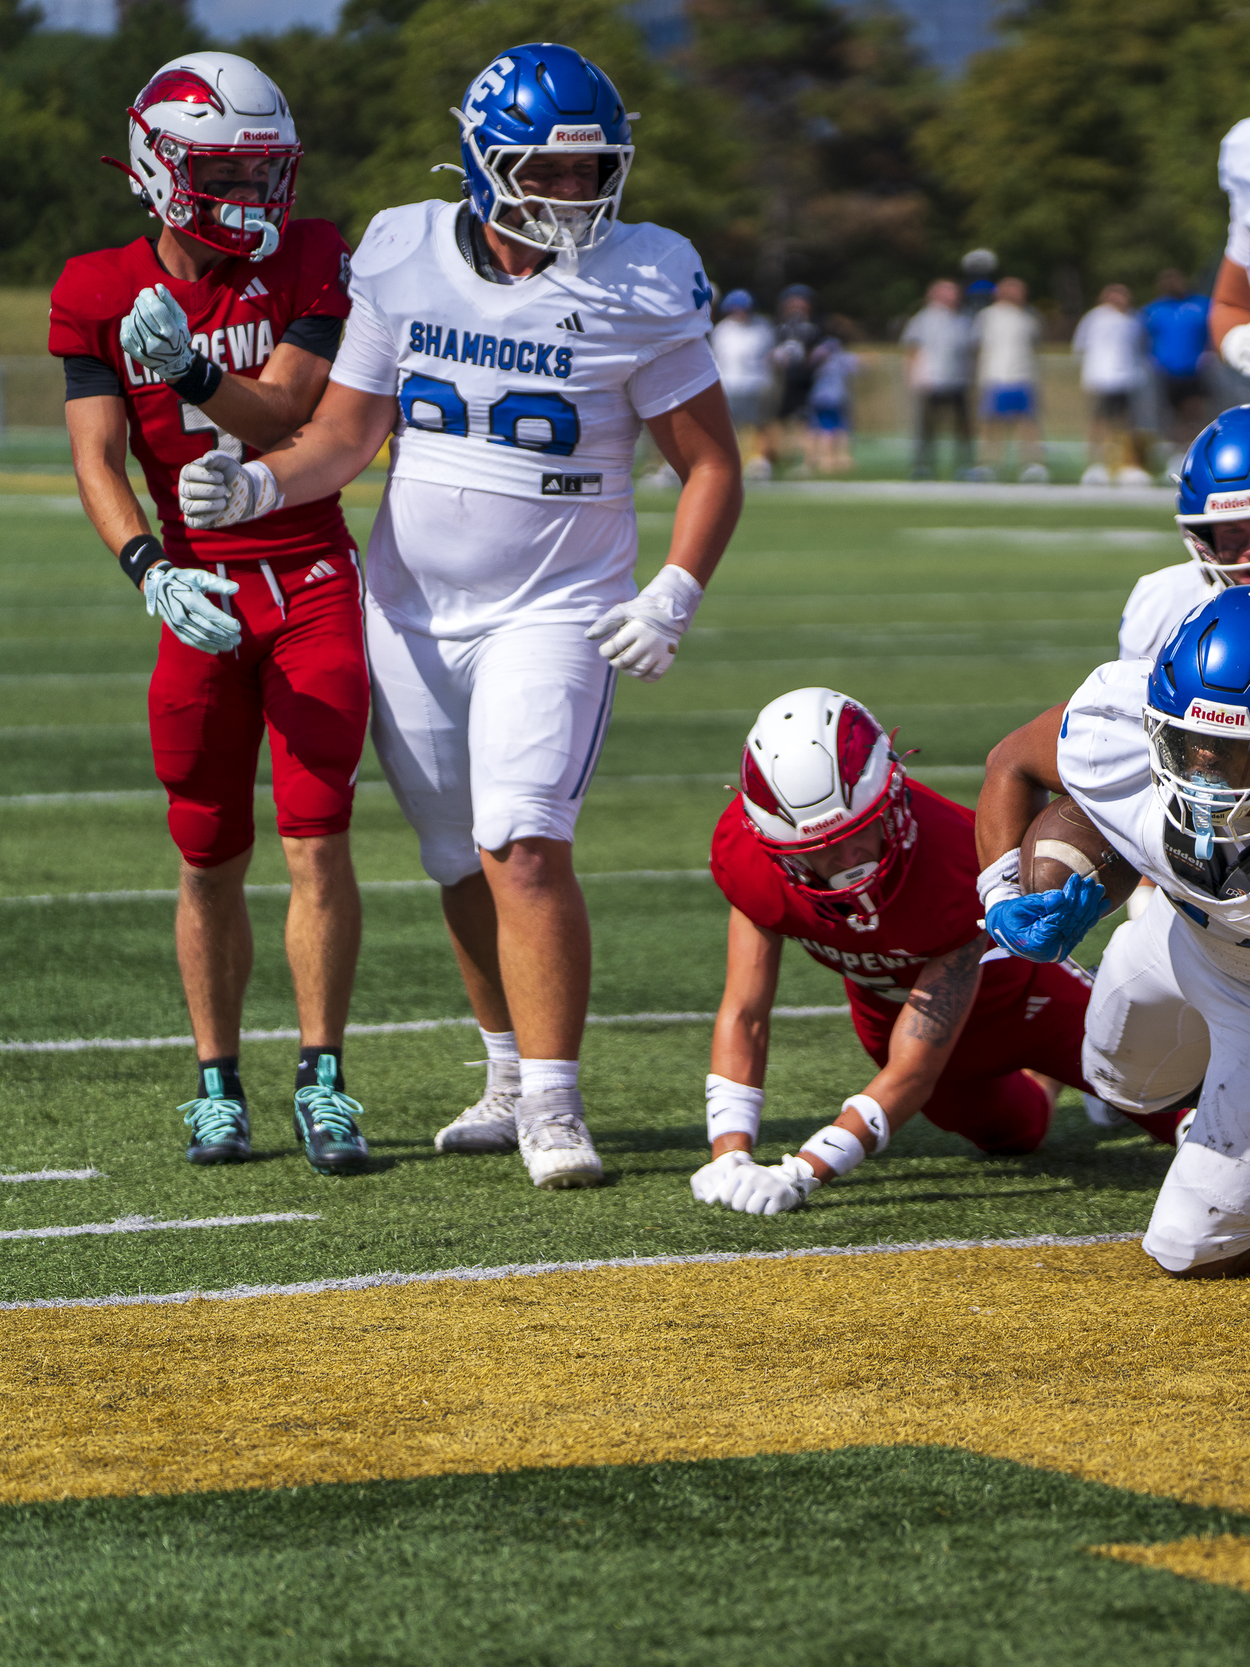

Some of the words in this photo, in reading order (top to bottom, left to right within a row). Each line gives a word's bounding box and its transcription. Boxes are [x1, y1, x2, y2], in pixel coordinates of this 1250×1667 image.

[243, 131, 279, 141] Riddell
[556, 131, 602, 142] Riddell
[409, 320, 574, 379] SHAMROCKS
[1191, 706, 1246, 726] Riddell
[802, 812, 844, 836] Riddell
